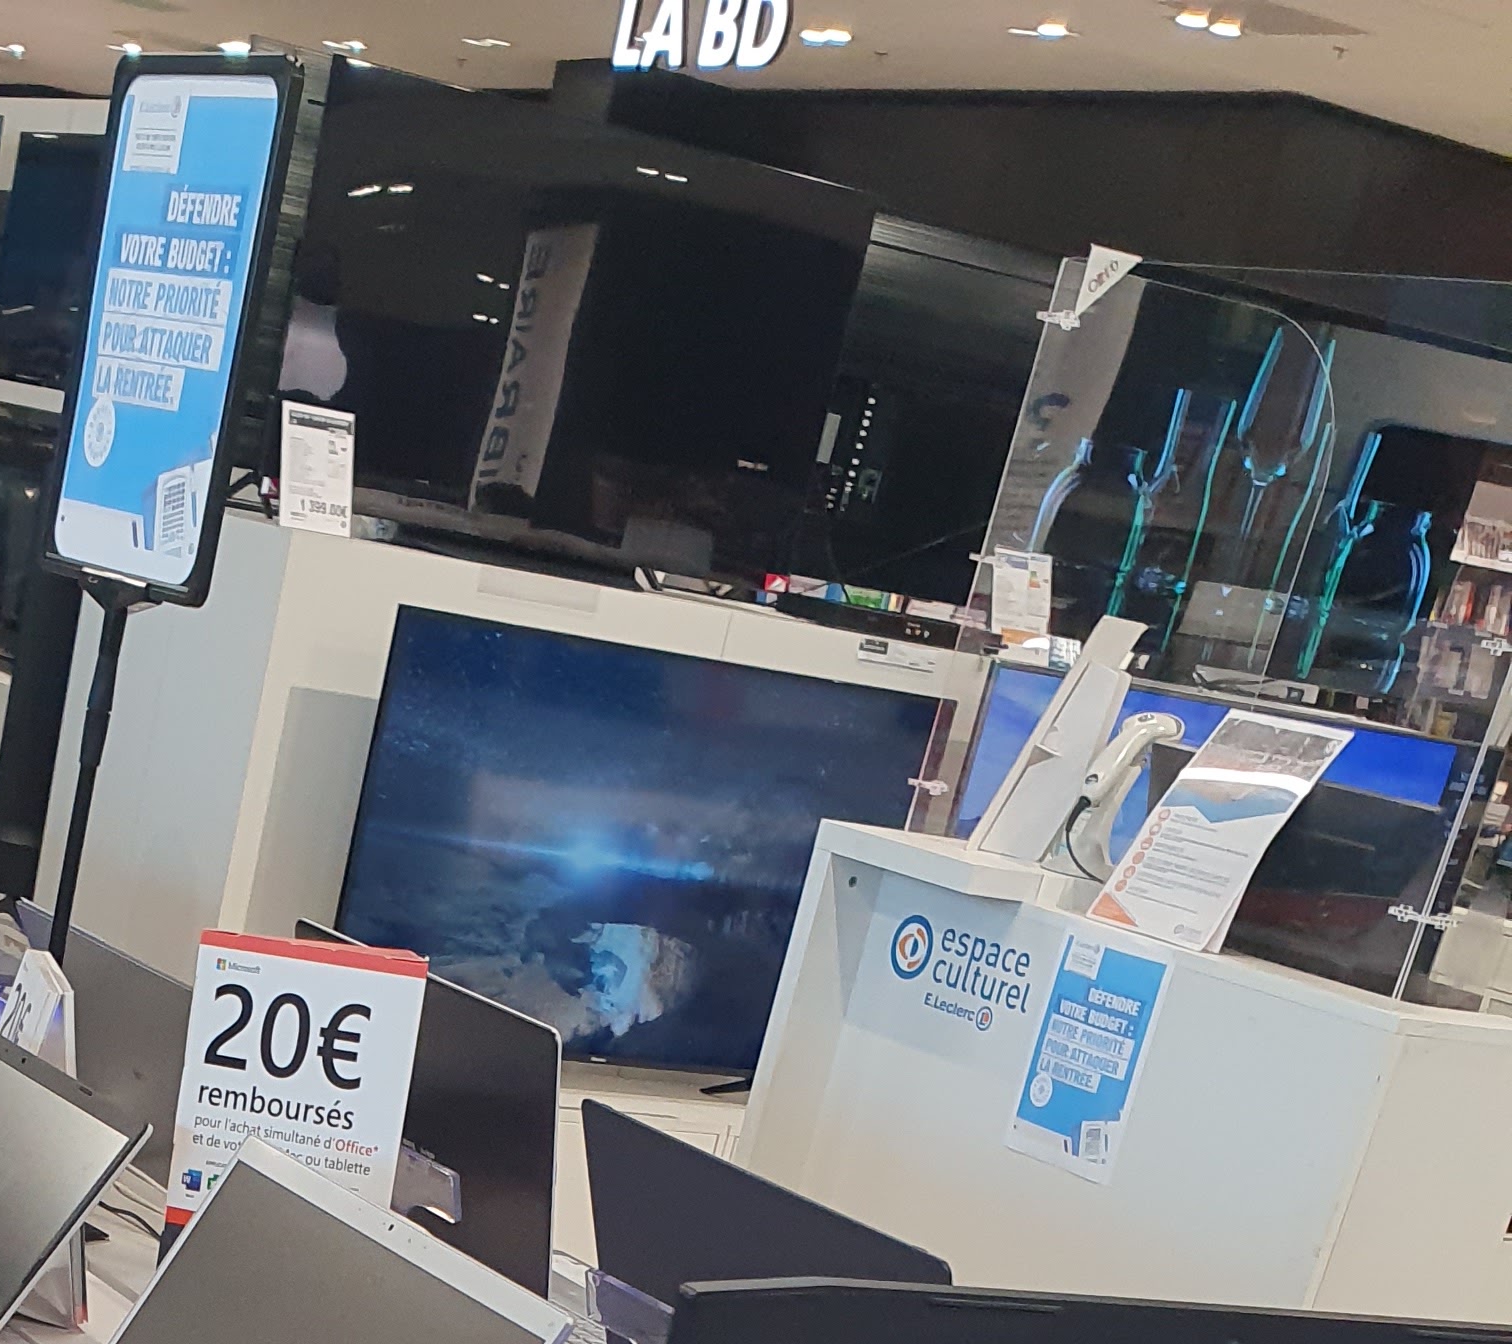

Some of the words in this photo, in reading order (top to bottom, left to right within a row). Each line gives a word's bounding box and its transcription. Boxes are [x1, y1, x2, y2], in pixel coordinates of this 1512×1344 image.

[610, 0, 687, 72] LA
[696, 0, 790, 71] BD
[167, 184, 242, 228] DÉFENDRE
[120, 233, 167, 268] VOTRE
[108, 277, 153, 311] NOTRE
[154, 281, 221, 319] PRIORITÉ
[102, 321, 137, 354] POUR
[137, 326, 213, 364] ATTAQUER
[96, 364, 112, 394] LA
[941, 928, 1031, 978] espace
[932, 959, 1032, 1014] culturel
[203, 983, 373, 1090] 20€
[197, 1083, 355, 1131] remboursés
[192, 1133, 204, 1147] et
[206, 1133, 222, 1150] de
[194, 1115, 222, 1135] pour
[225, 1117, 262, 1138] l'achat
[263, 1125, 322, 1149] simultané
[304, 1154, 322, 1170] ou
[324, 1156, 371, 1177] tablette
